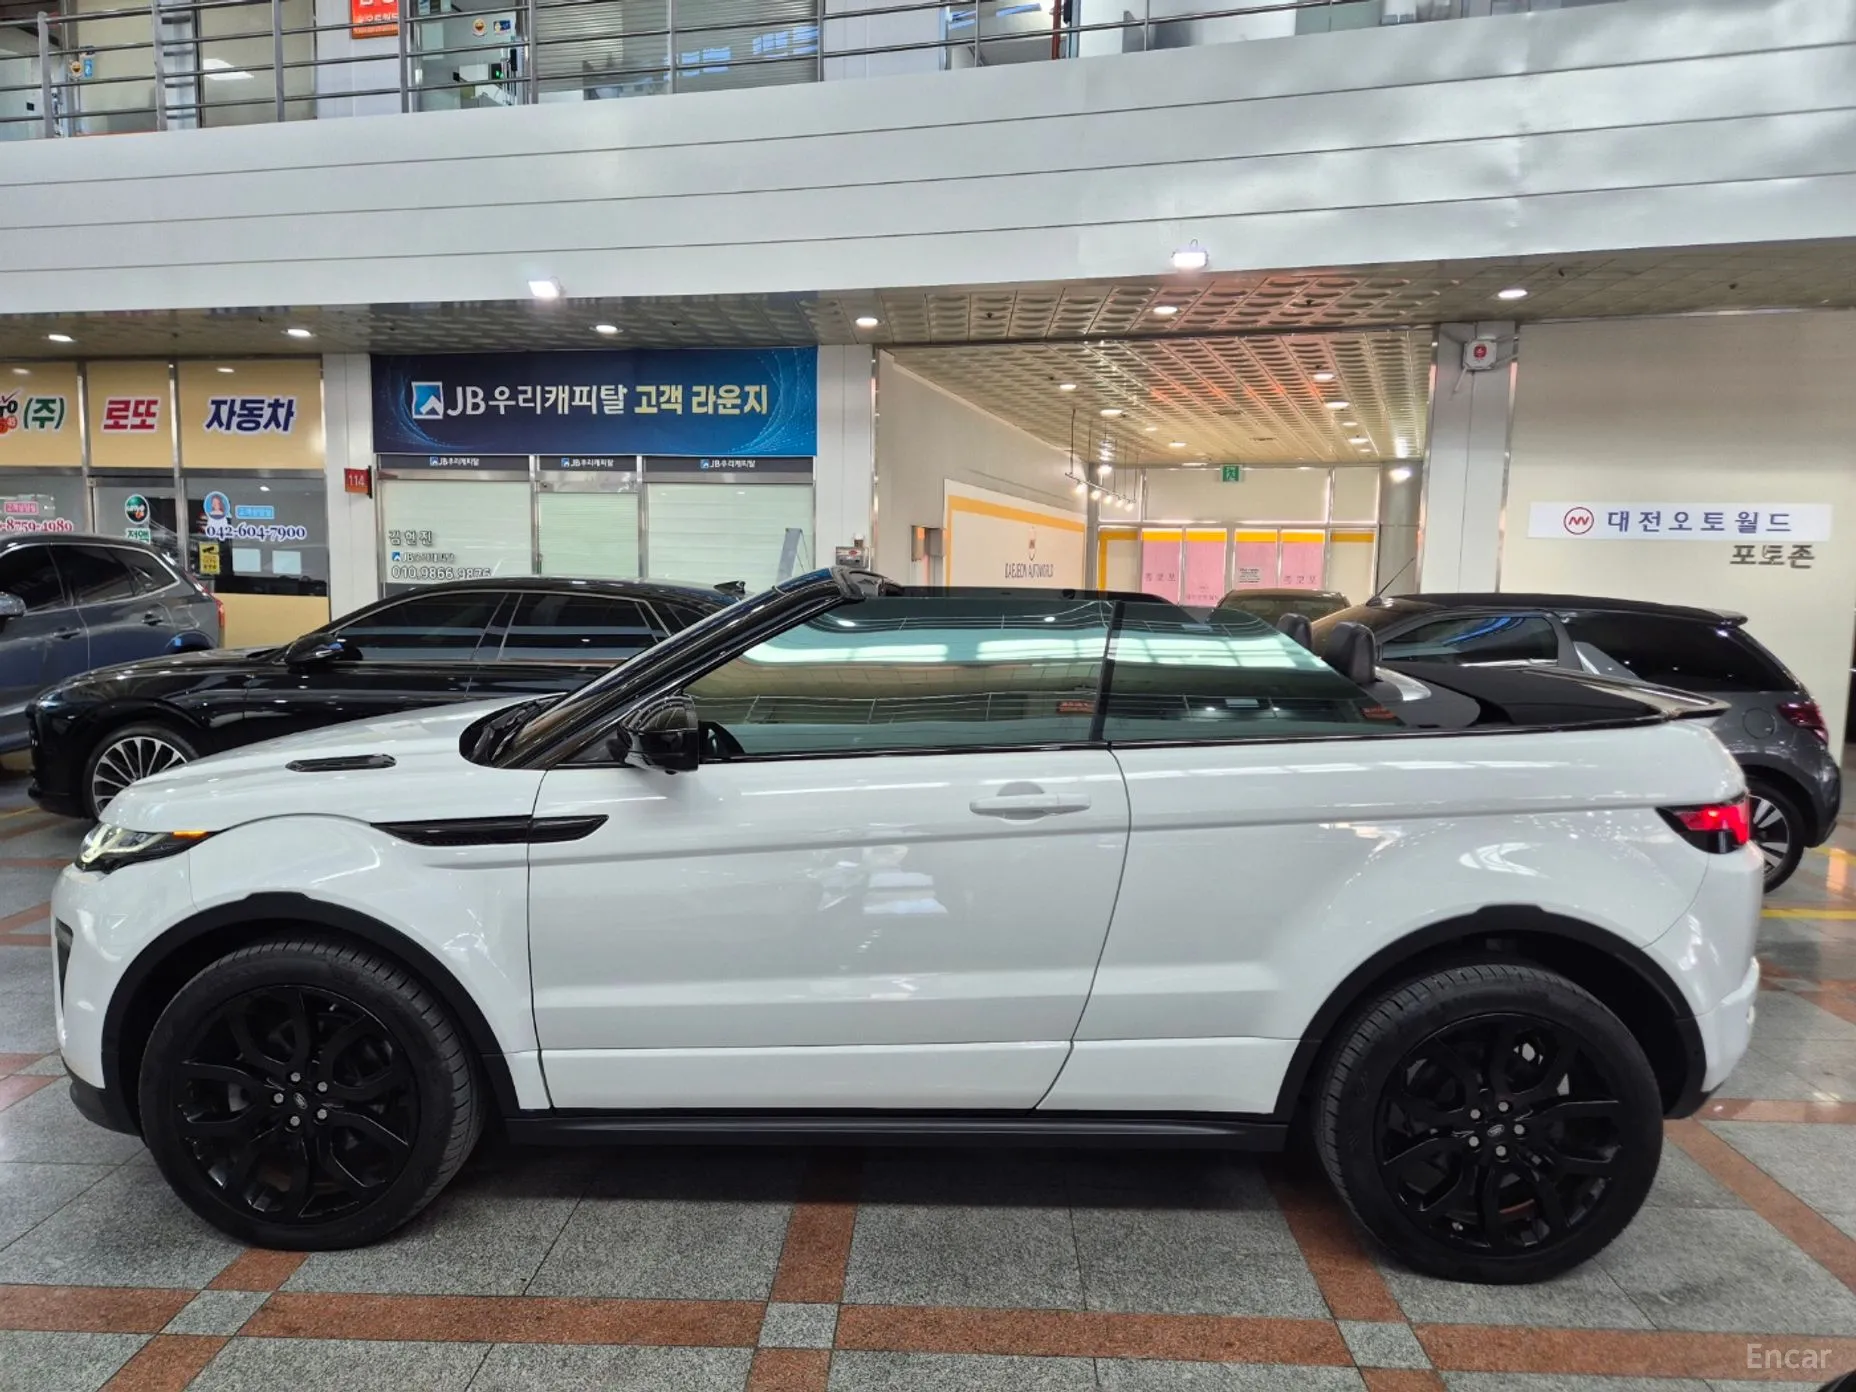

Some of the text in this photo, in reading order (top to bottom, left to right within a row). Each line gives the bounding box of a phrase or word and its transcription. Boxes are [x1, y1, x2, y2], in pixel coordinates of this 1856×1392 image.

[23, 397, 65, 429] (주)
[103, 400, 159, 430] 로또
[205, 398, 294, 432] 자동차
[447, 384, 768, 416] JB우리캐피탈 고객 라운지
[206, 522, 306, 540] 042-604-7900
[1607, 511, 1791, 533] 대전오토월드
[1729, 544, 1815, 569] 포토존
